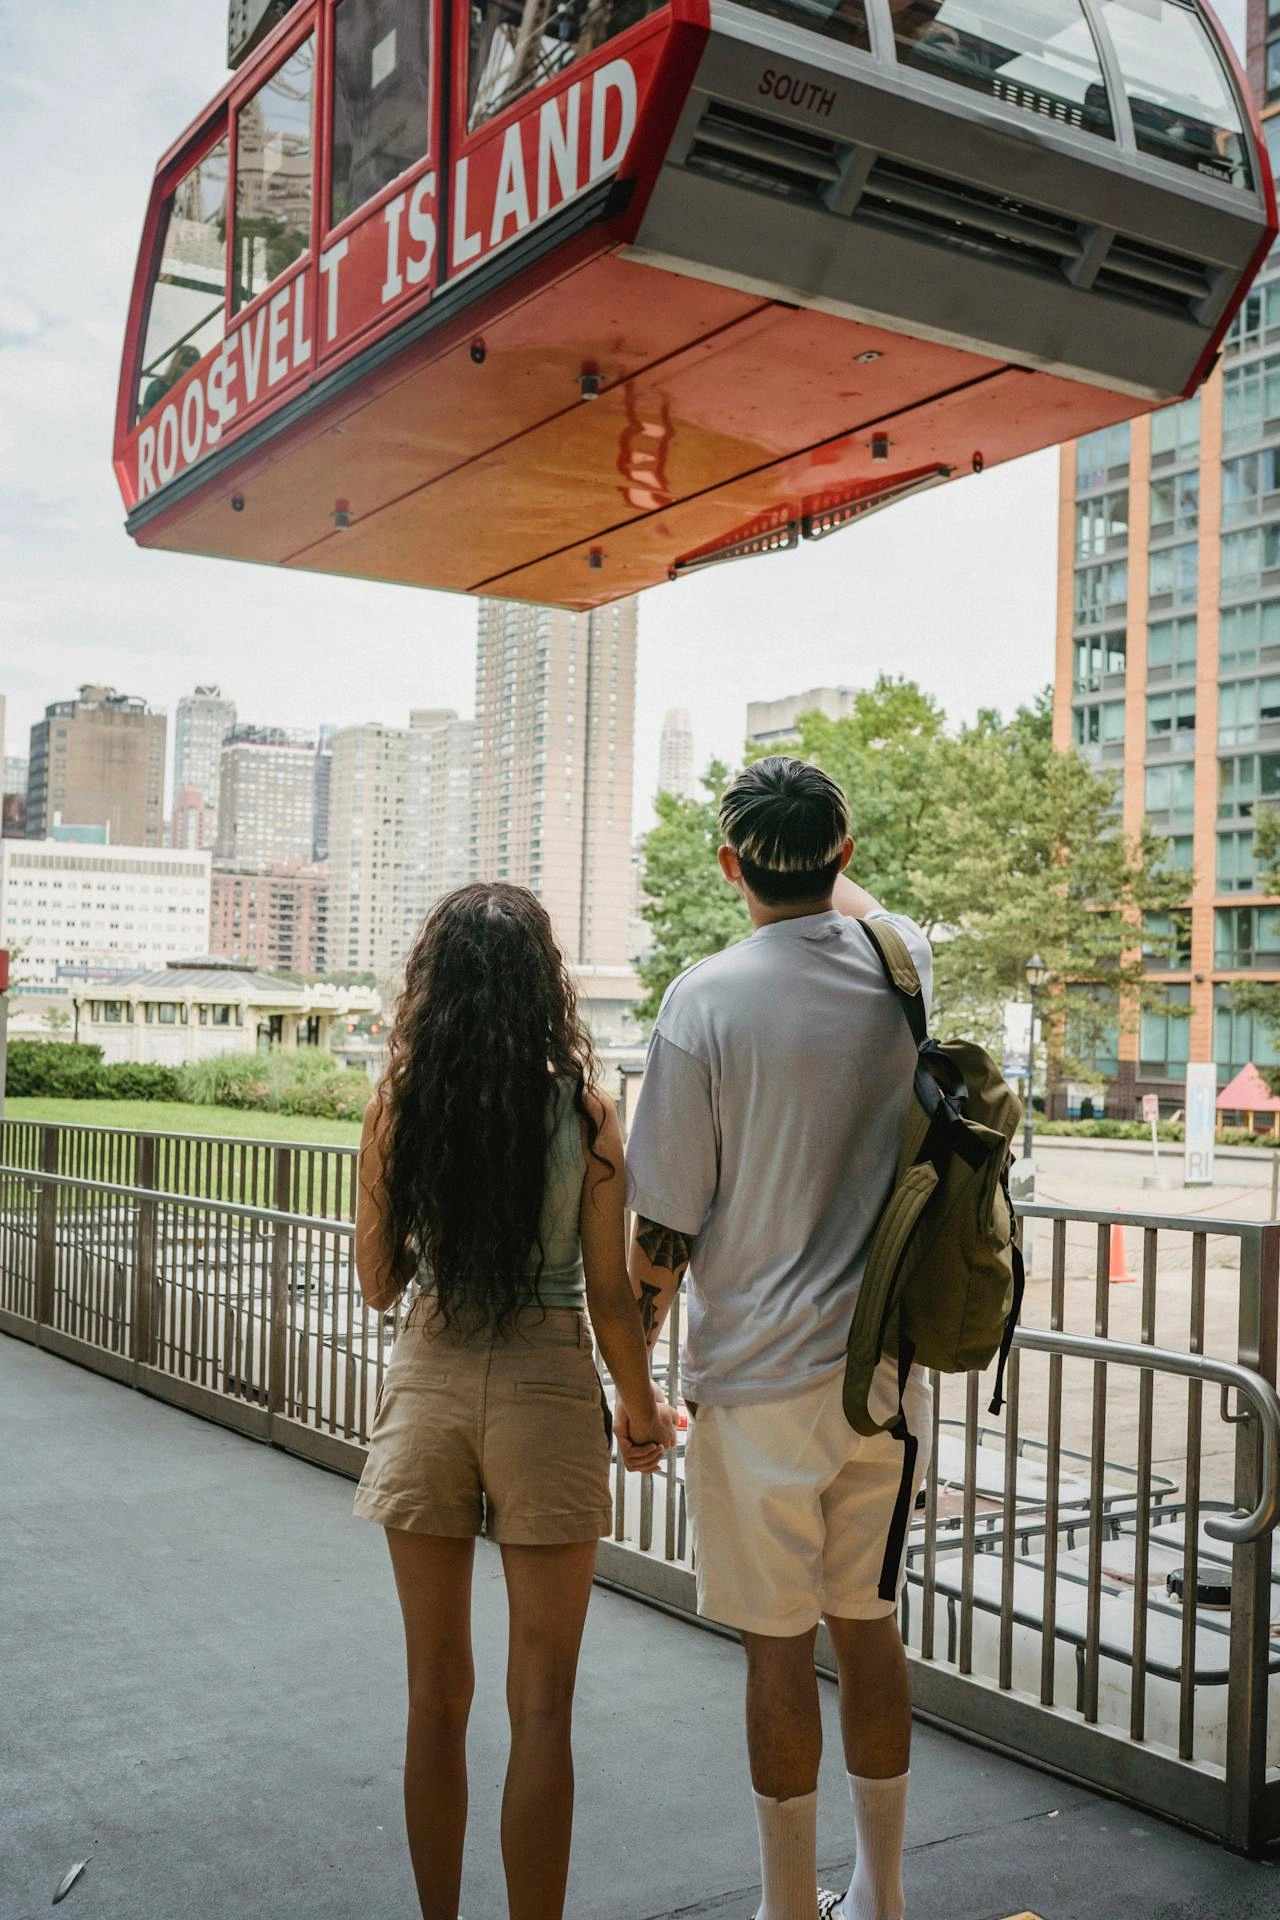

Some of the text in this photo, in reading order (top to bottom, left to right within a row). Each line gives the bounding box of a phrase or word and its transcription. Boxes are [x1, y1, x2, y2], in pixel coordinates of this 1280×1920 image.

[758, 69, 837, 116] SOUTH
[138, 59, 637, 500] ROOSEVELT ISLAND
